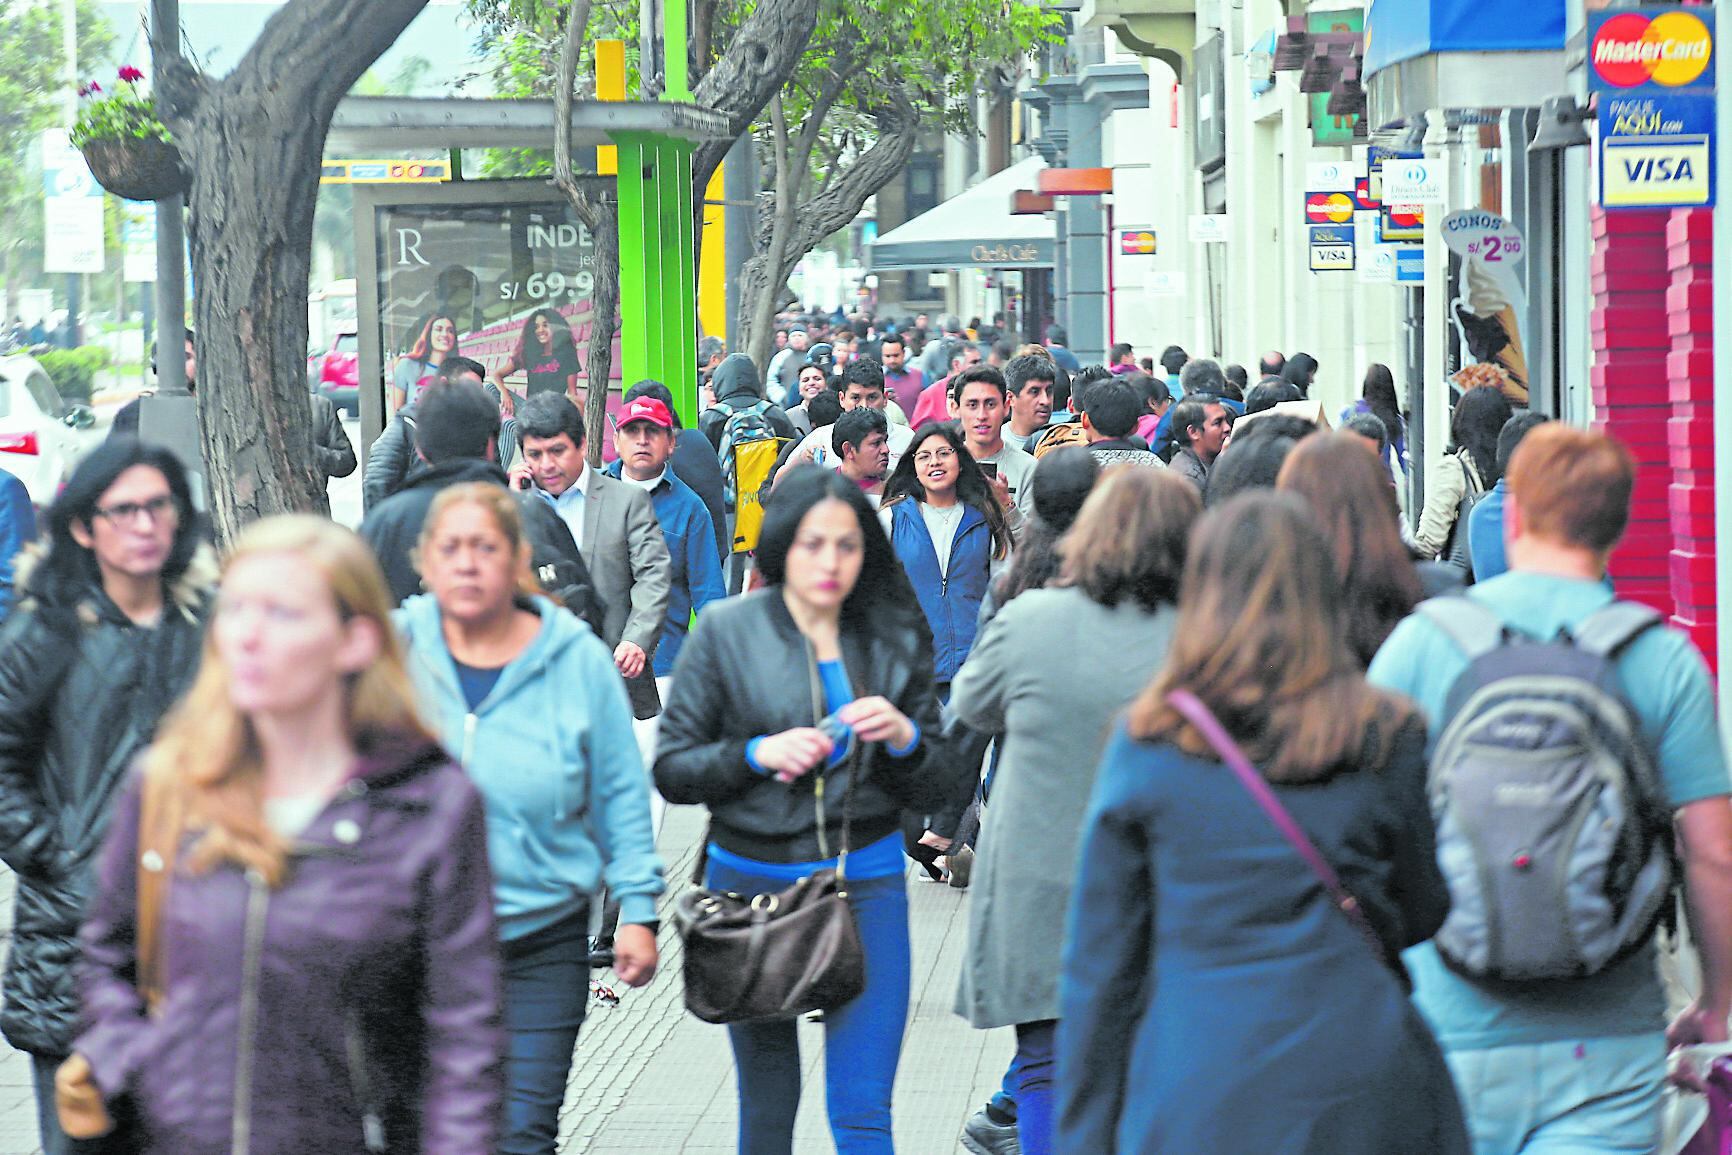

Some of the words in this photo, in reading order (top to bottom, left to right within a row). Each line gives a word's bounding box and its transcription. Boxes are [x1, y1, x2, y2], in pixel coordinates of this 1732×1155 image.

[1595, 39, 1707, 63] MasterCard
[1624, 158, 1694, 181] VISA
[1448, 215, 1501, 232] CONOS
[396, 228, 431, 265] R
[1318, 250, 1347, 261] VISA
[1483, 235, 1502, 262] 2
